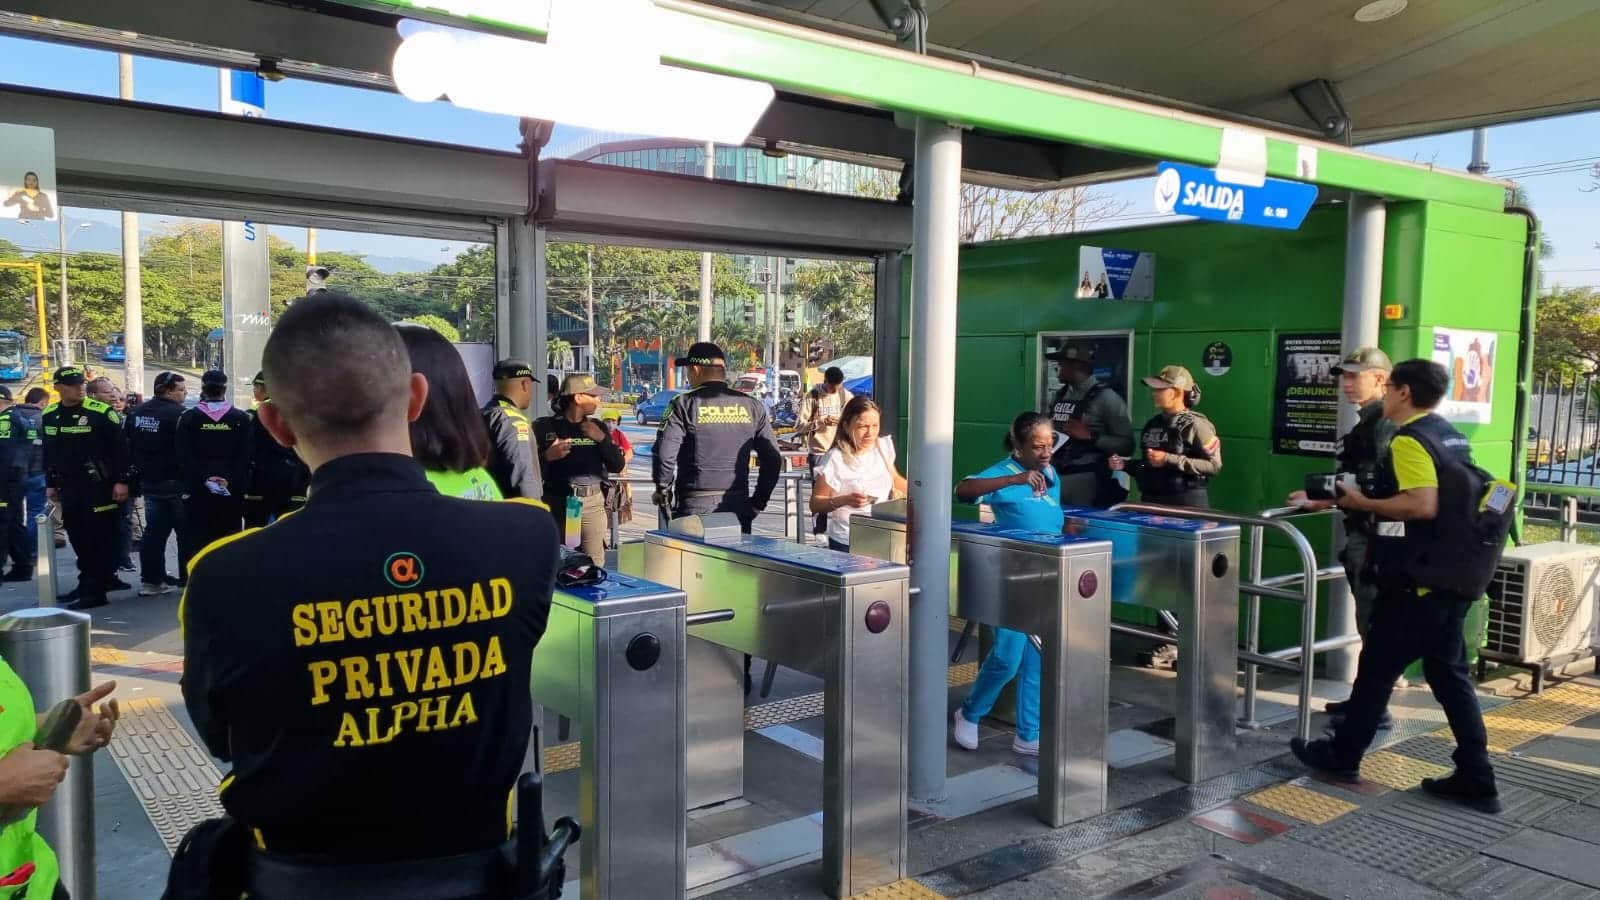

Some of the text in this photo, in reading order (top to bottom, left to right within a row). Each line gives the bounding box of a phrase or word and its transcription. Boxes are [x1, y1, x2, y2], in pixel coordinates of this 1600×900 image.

[1182, 181, 1244, 213] SALIDA
[698, 403, 749, 417] POLICÍA
[292, 577, 513, 647] SEGURIDAD
[308, 636, 506, 705] PRIVADA
[333, 692, 479, 747] ALPHA
